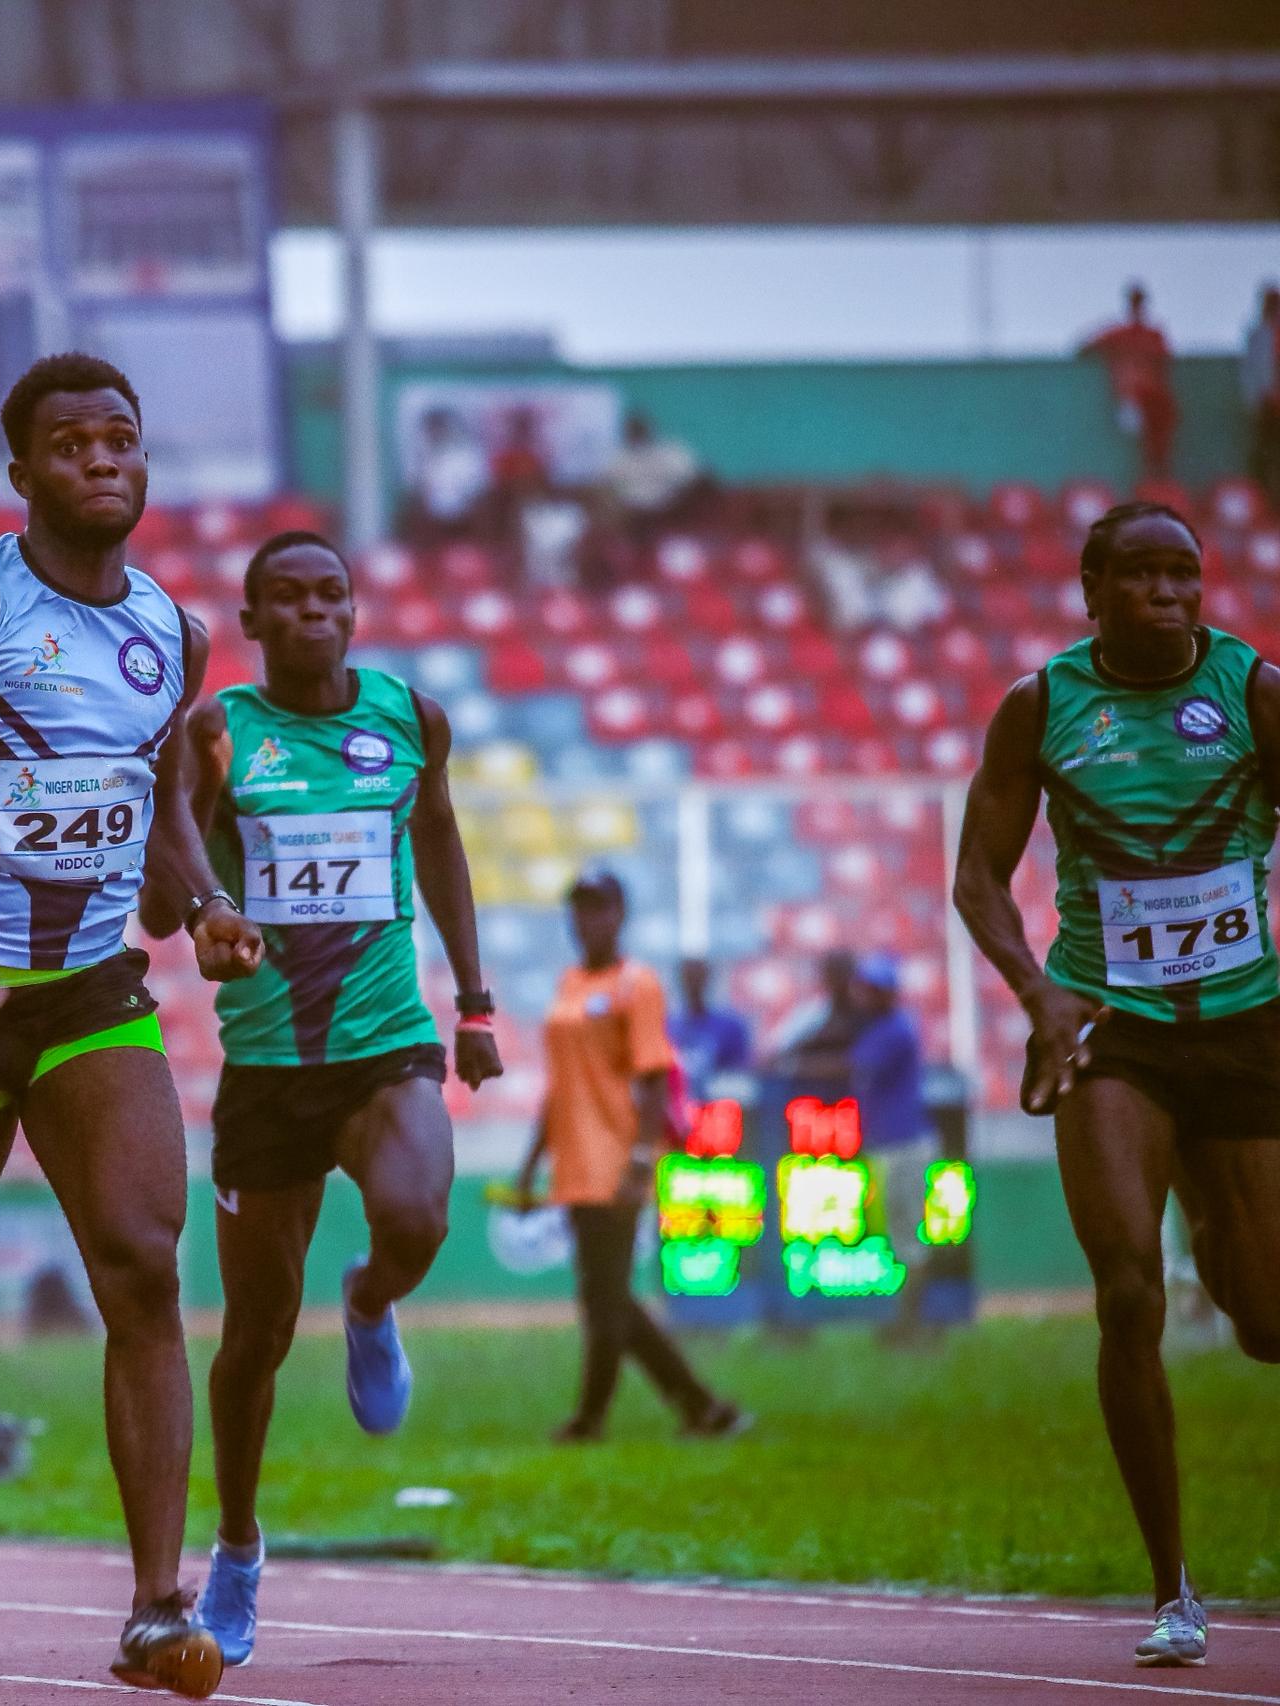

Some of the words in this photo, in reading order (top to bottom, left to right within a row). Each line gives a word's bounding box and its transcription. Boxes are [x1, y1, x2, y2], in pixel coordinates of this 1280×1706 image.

[4, 680, 31, 690] NIGER
[33, 682, 58, 692] DELTA
[59, 685, 84, 696] GAMES
[1185, 744, 1225, 757] NDDC
[45, 781, 72, 795] NIGER
[74, 778, 101, 793] DELTA
[353, 776, 391, 788] NDDC
[13, 804, 133, 852] 249
[54, 856, 92, 871] NDDC
[258, 859, 361, 897] 147
[1143, 899, 1172, 912] NIGER
[1173, 895, 1201, 909] DELTA
[1202, 885, 1230, 904] GAMES
[290, 903, 328, 916] NDDC
[1122, 907, 1250, 961] 178
[1162, 960, 1201, 976] NDDC
